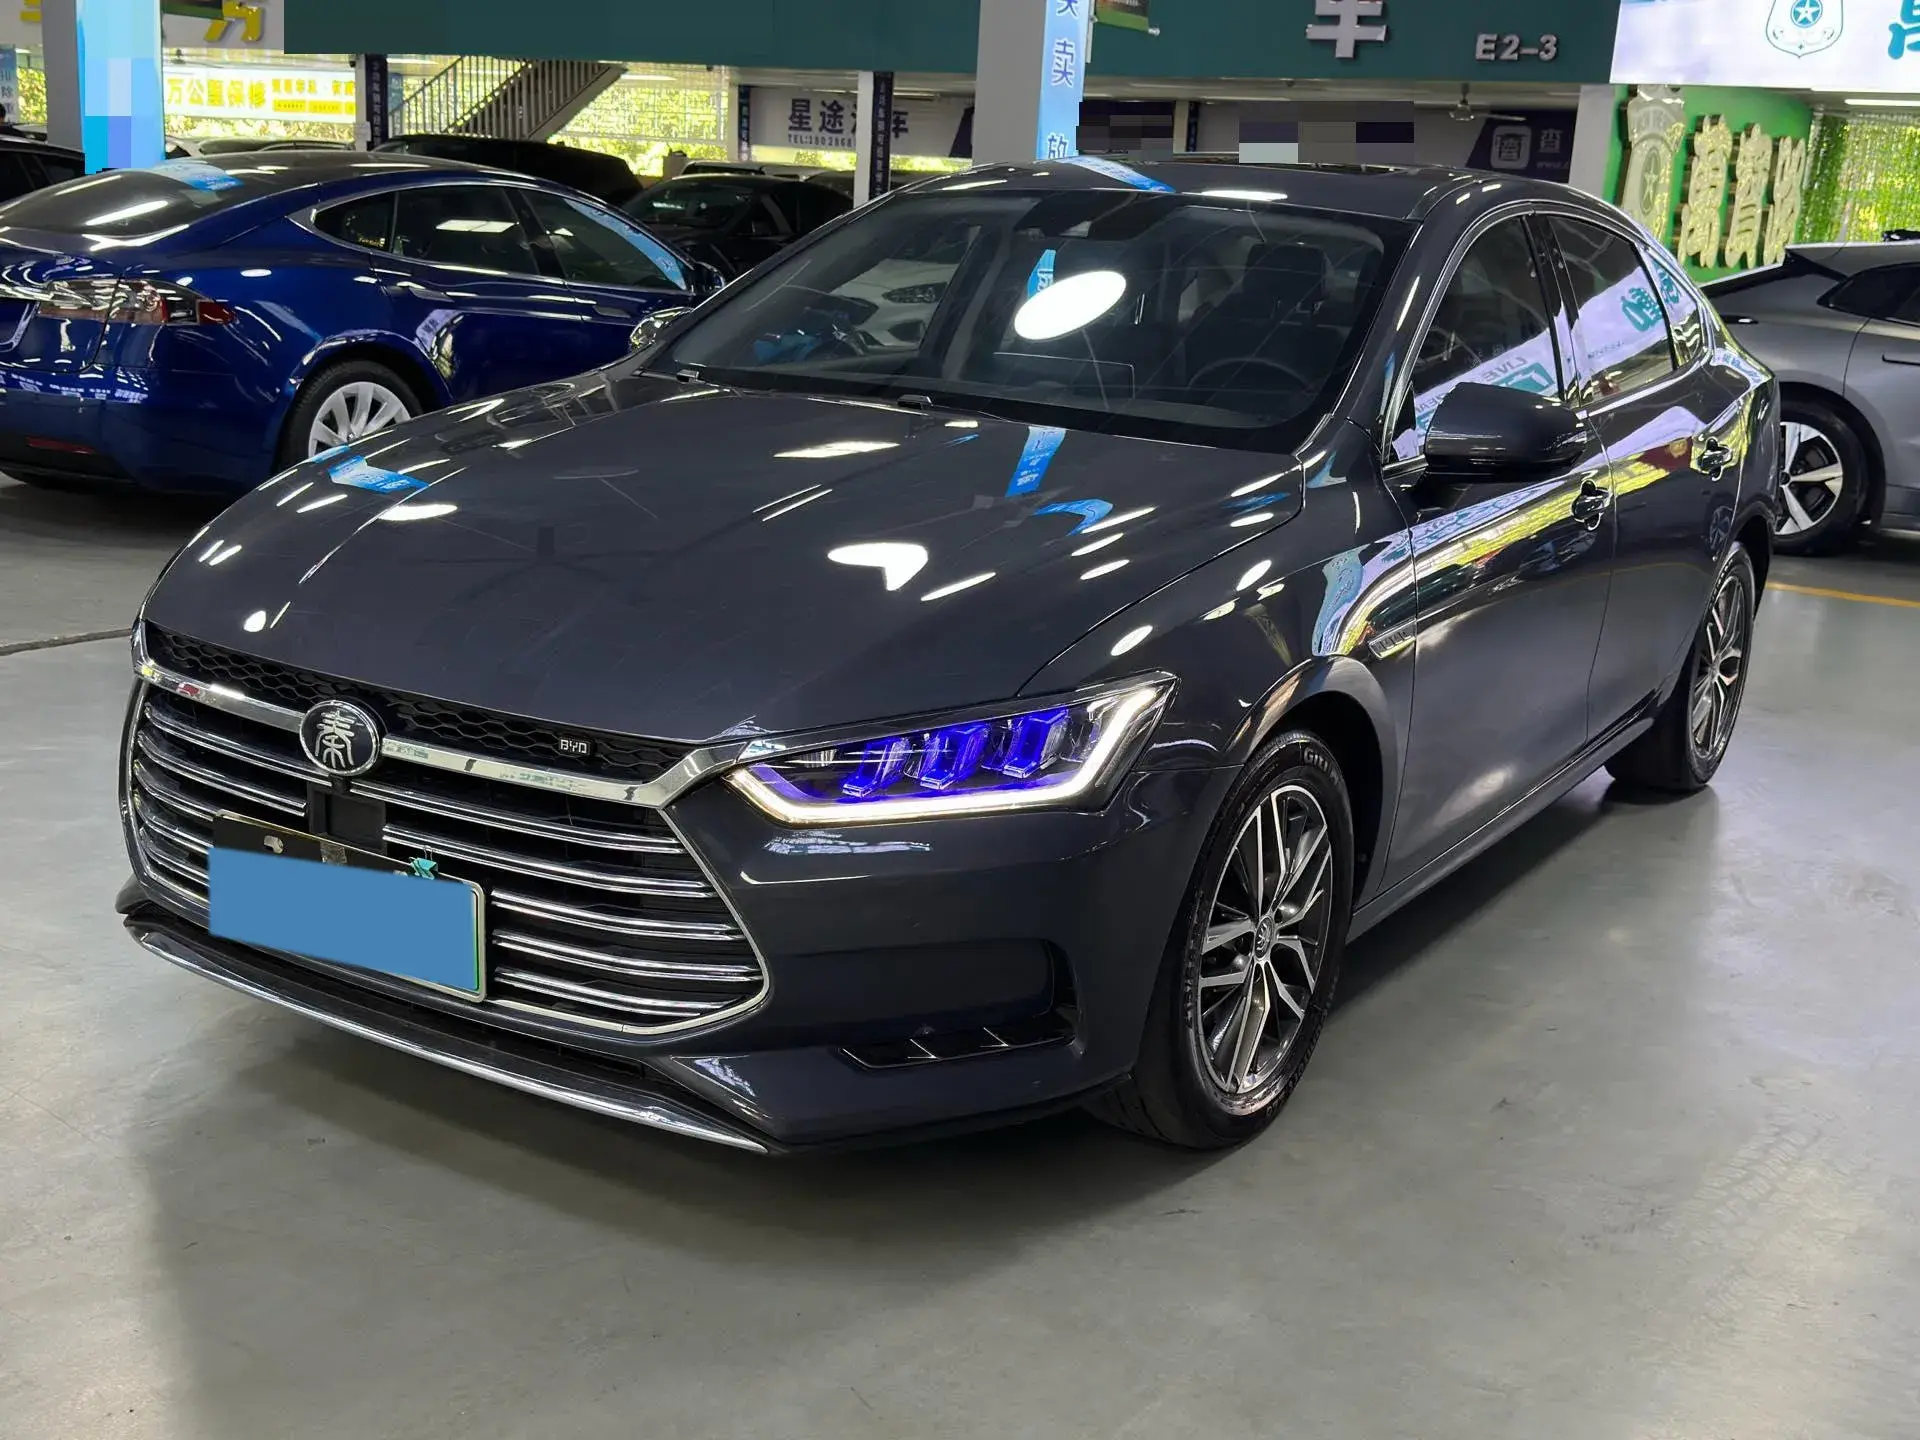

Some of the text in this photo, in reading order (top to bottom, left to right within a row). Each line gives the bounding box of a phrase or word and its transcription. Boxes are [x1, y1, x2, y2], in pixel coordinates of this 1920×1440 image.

[1475, 33, 1558, 61] E2-3
[788, 98, 909, 139] 星途车
[560, 739, 587, 754] BYD
